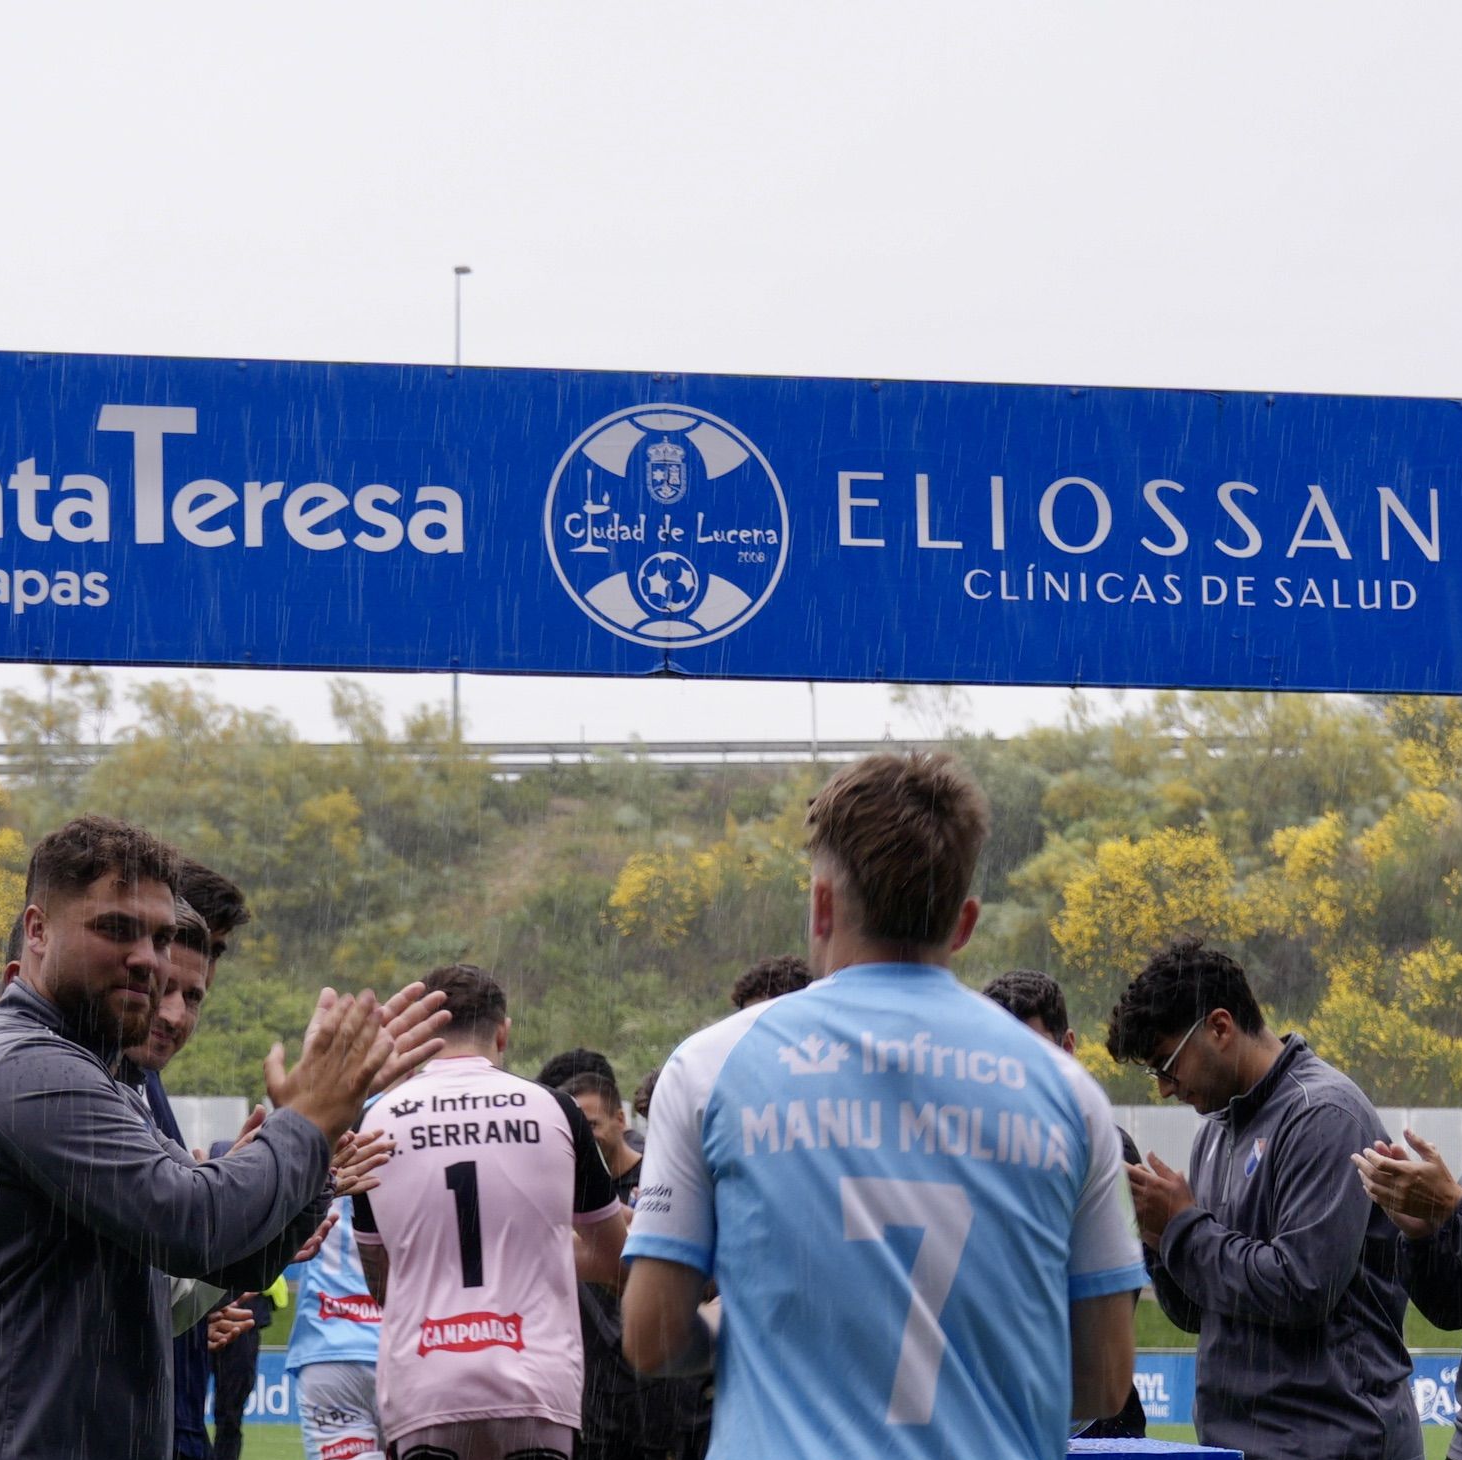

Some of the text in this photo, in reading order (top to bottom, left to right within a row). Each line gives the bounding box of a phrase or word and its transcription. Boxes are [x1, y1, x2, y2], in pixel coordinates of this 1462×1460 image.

[657, 514, 685, 542] de
[697, 511, 779, 545] Lucena
[737, 551, 766, 563] 2008
[963, 564, 1418, 610] CLÍNICAS DE SALUD
[859, 1031, 1028, 1090] Infrico
[431, 1092, 526, 1113] Infrico
[410, 1119, 541, 1151] SERRANO
[741, 1098, 1072, 1175] MANU MOLINA
[444, 1160, 484, 1288] 1
[840, 1176, 974, 1425] 7
[421, 1318, 518, 1348] CAMPOARAS
